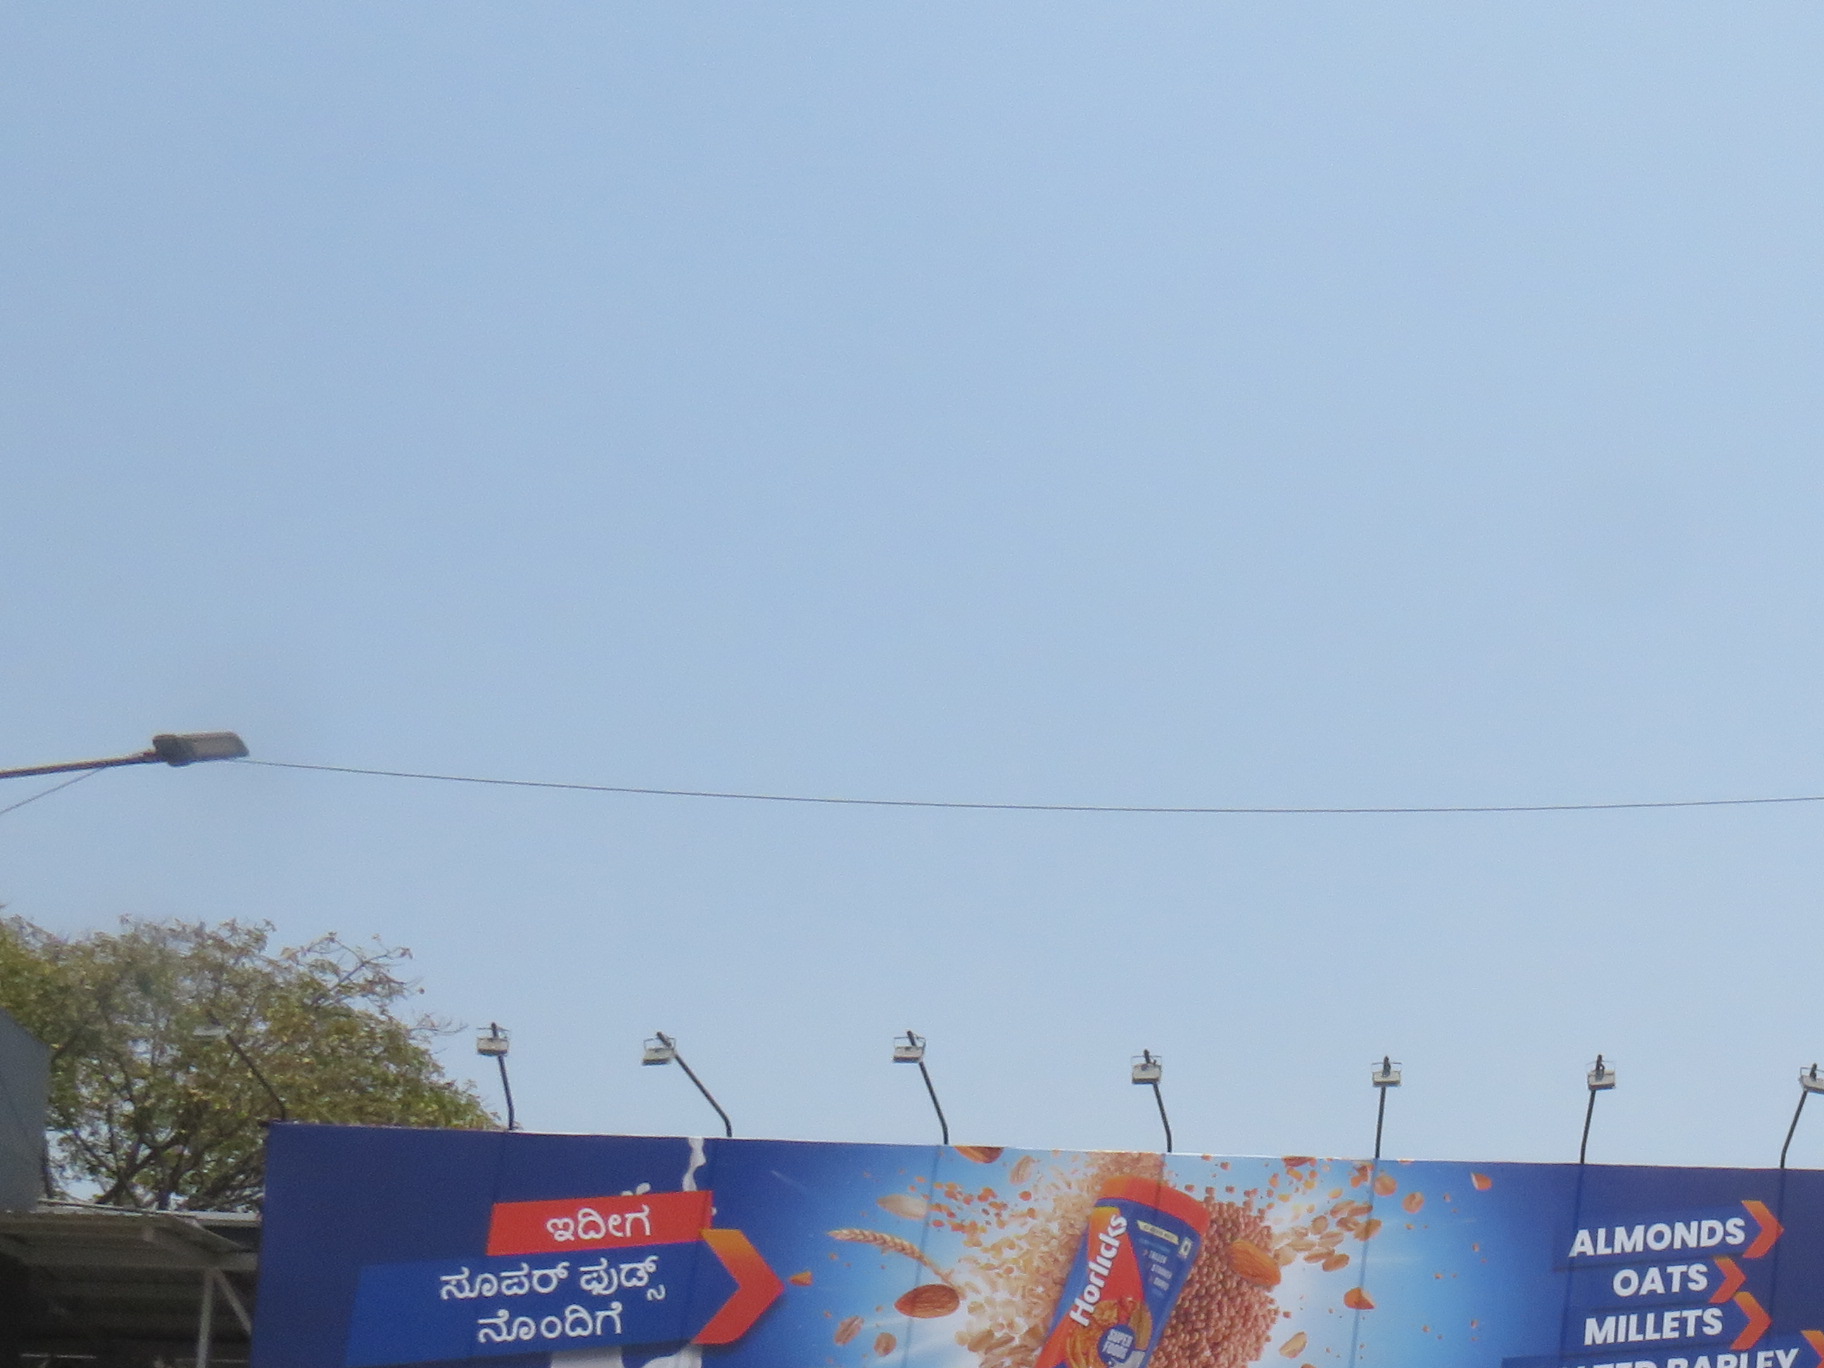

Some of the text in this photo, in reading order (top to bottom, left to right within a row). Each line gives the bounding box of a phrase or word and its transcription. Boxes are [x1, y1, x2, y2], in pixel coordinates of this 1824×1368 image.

[547, 1204, 651, 1242] ಇದೀಗ
[1569, 1217, 1746, 1258] ALMONDS
[440, 1262, 570, 1300] ಸೂಪರ್
[1068, 1214, 1128, 1327] Horlicks
[1612, 1262, 1708, 1298] OATS
[477, 1301, 622, 1343] ನೊಂದಿಗೆ
[1583, 1307, 1723, 1346] MILLETS
